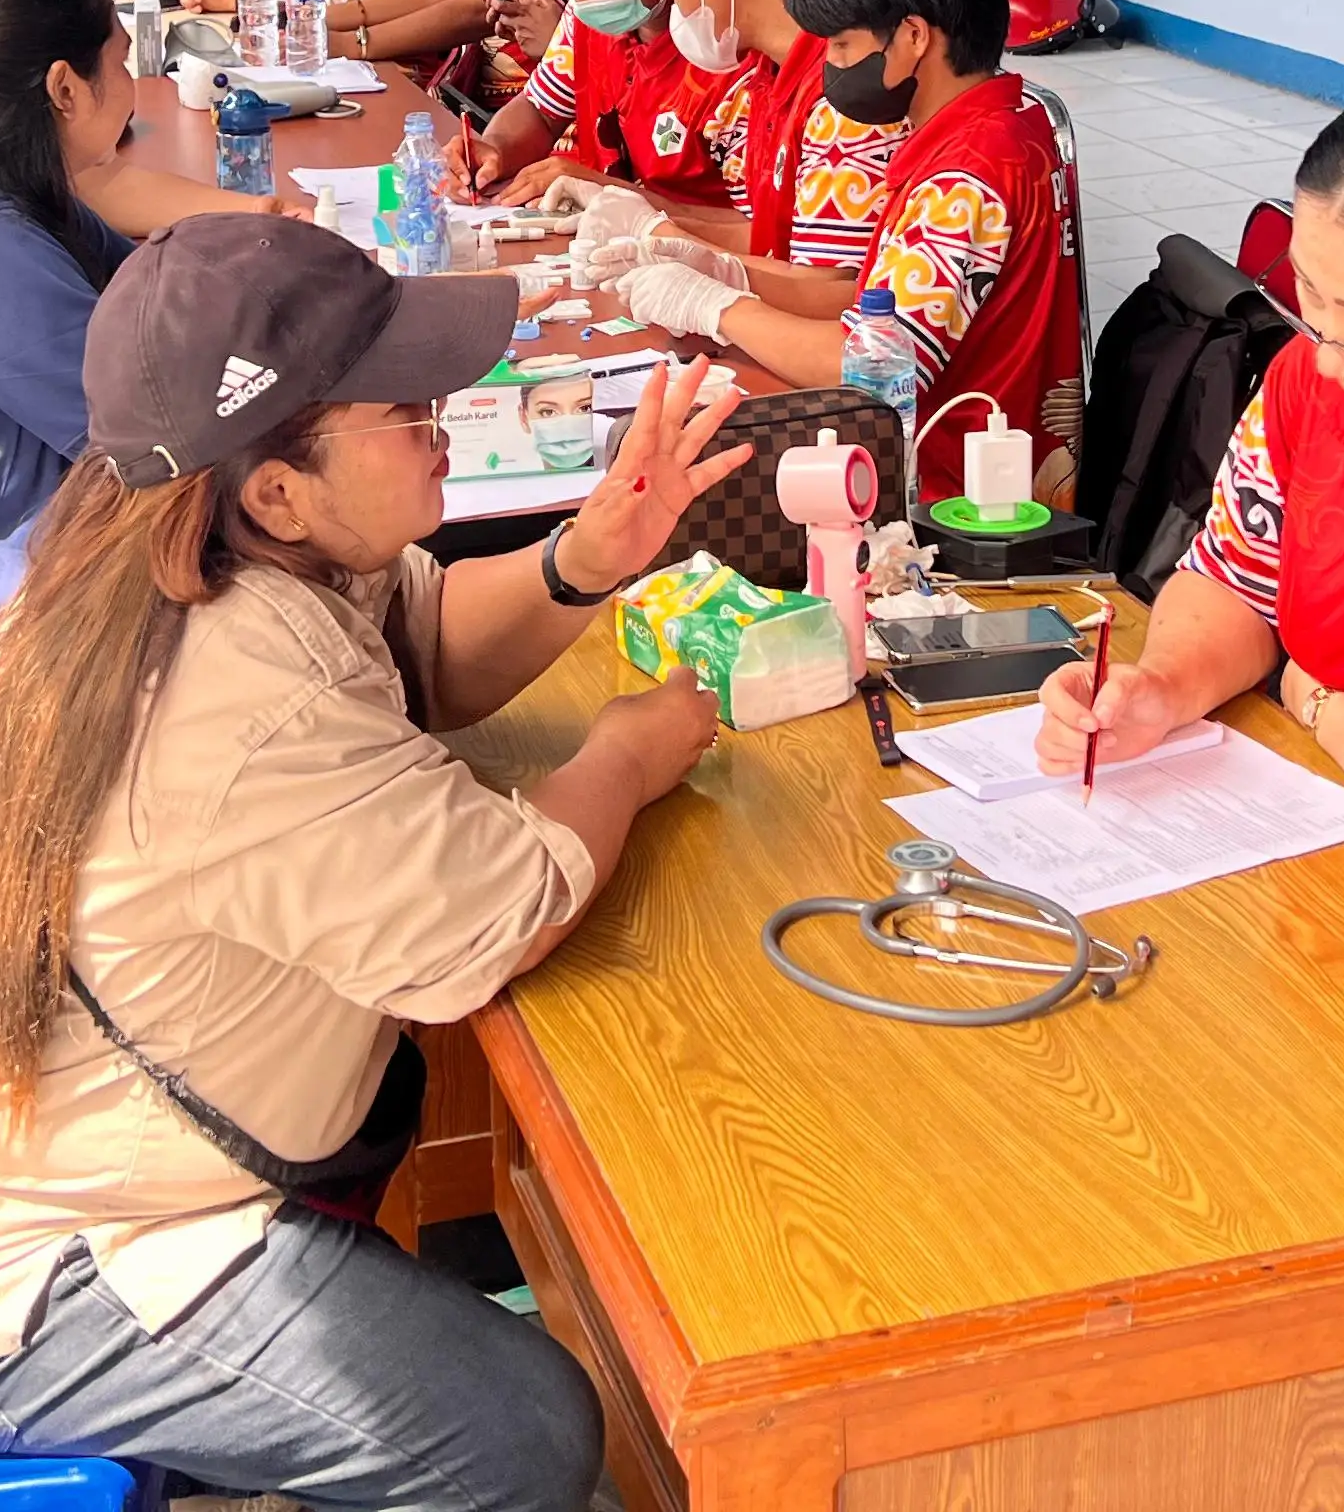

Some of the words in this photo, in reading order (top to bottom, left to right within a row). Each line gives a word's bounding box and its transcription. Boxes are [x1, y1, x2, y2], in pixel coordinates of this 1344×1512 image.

[216, 368, 278, 418] adidas
[447, 413, 474, 423] Bedah
[474, 411, 498, 420] Karet
